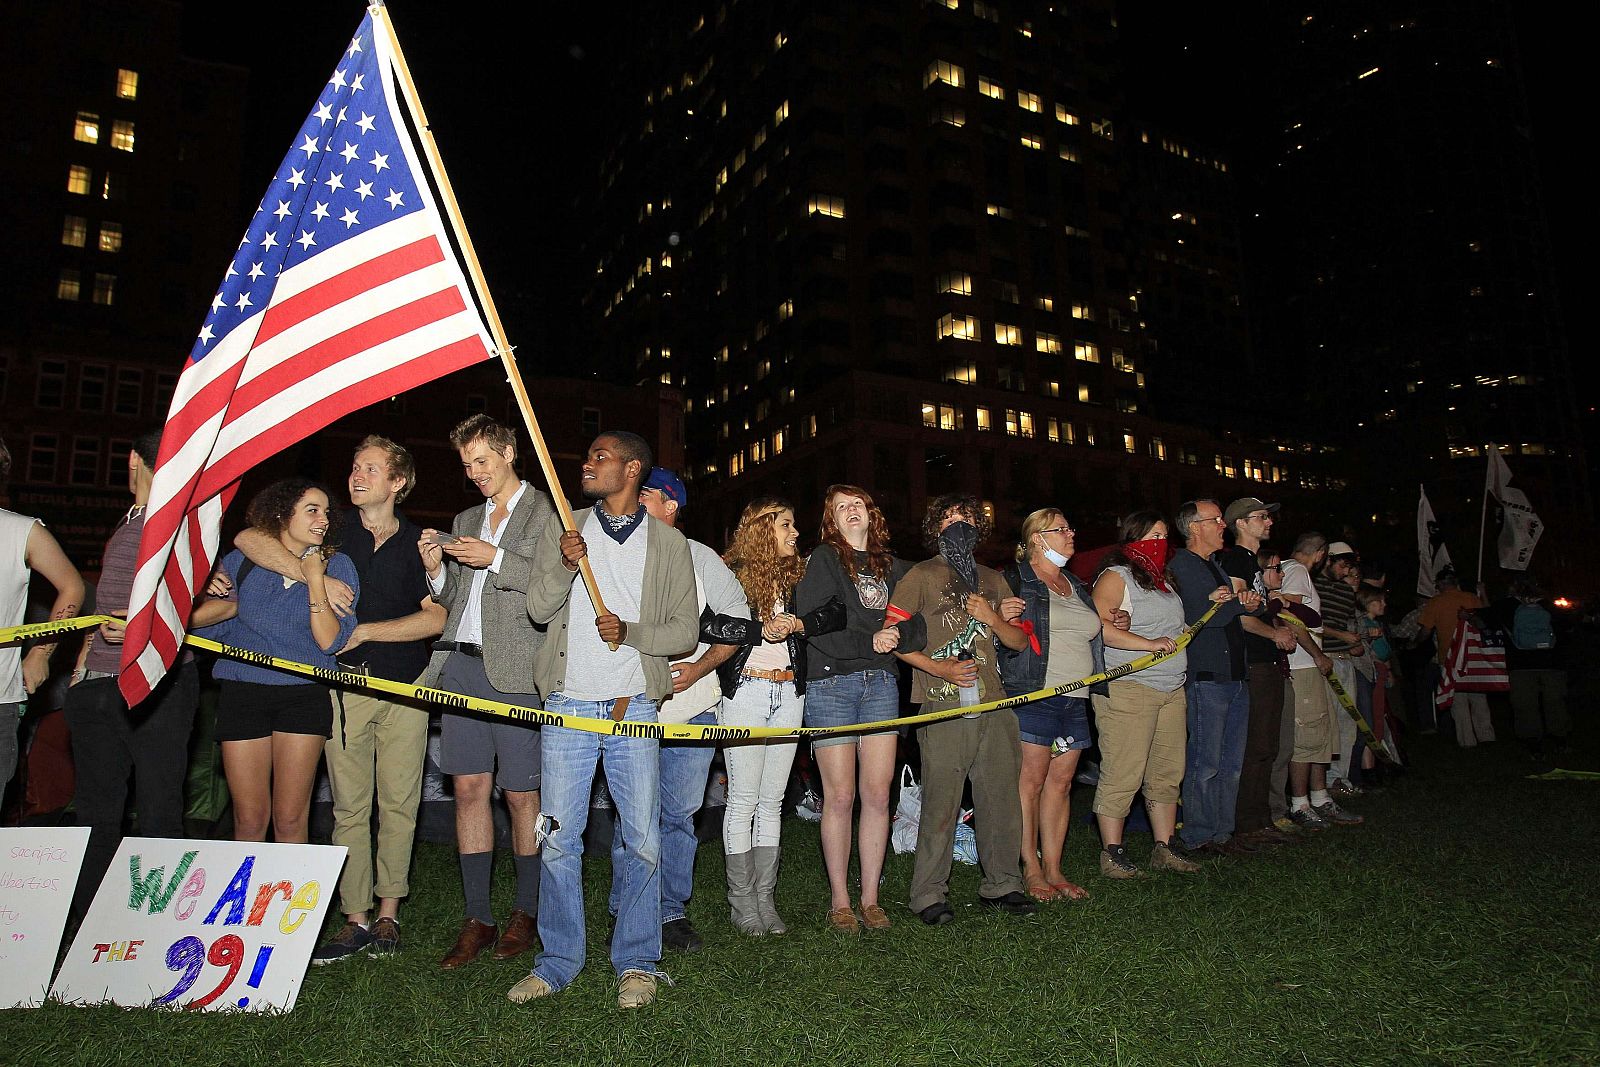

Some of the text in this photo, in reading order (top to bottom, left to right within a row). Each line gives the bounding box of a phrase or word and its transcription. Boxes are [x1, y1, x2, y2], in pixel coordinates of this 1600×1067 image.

[414, 688, 468, 709] CAUTION
[612, 723, 664, 739] CAUTION
[11, 846, 69, 865] sacrifice
[128, 851, 321, 935] We Are
[93, 940, 145, 963] THE
